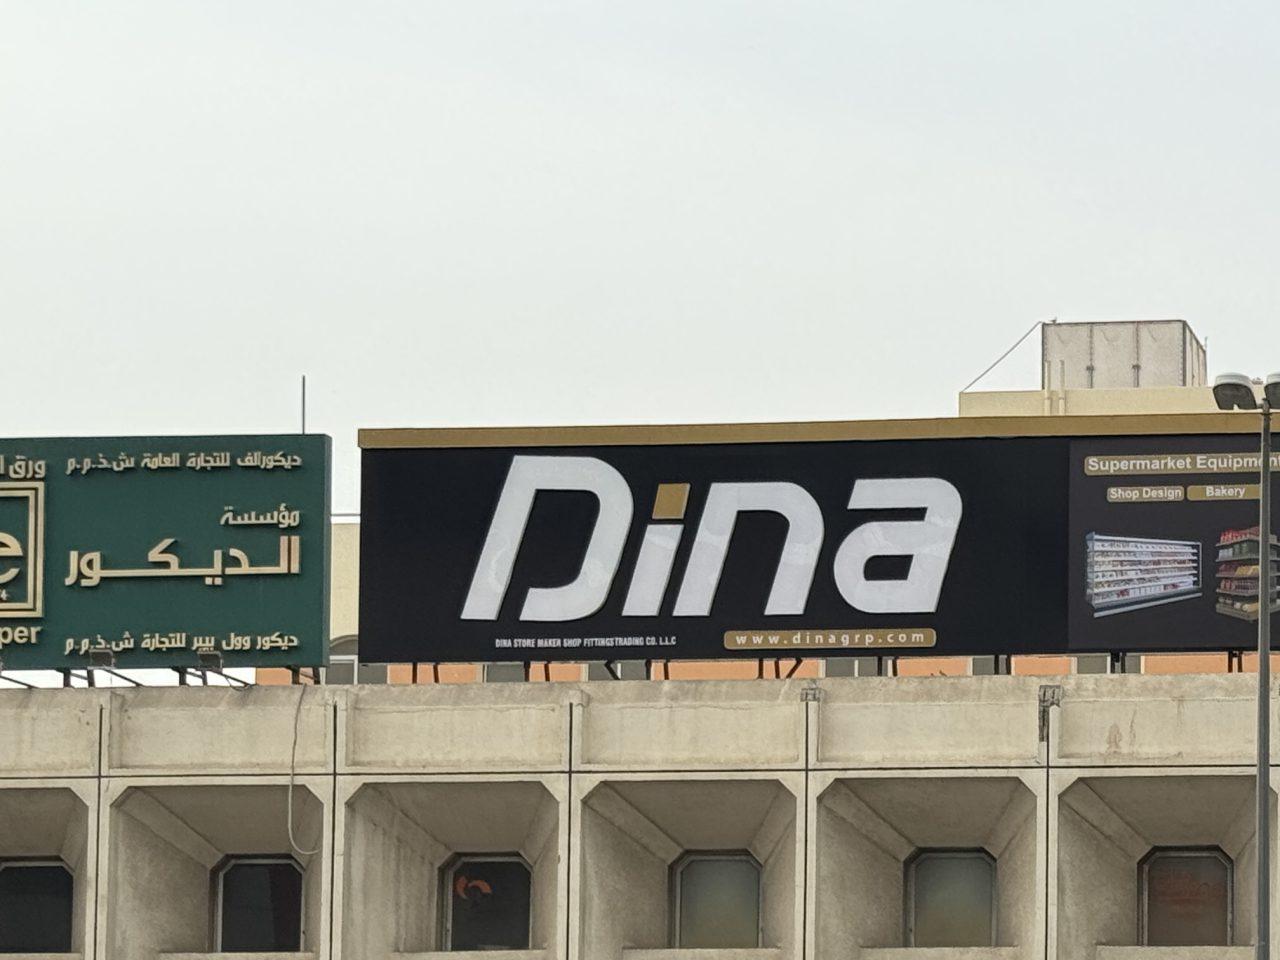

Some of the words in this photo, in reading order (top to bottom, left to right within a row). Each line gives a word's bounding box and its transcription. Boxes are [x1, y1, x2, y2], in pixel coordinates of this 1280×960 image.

[141, 452, 180, 469] العامة
[186, 451, 230, 470] للتجارة
[1087, 455, 1192, 473] Supermarket
[1109, 488, 1140, 500] Shop
[1142, 487, 1183, 500] Design
[1206, 485, 1246, 499] Bakery
[220, 503, 300, 527] مؤسسة
[460, 455, 963, 621] Dina
[65, 535, 301, 587] الديكور
[141, 633, 186, 651] للتجارة
[222, 633, 250, 651] وول
[256, 632, 298, 650] ديكور
[495, 638, 512, 648] DINA
[513, 638, 536, 648] STORE
[537, 638, 561, 648] MAKER
[563, 638, 582, 647] SHOP
[735, 630, 926, 647] www.dinagrp.com
